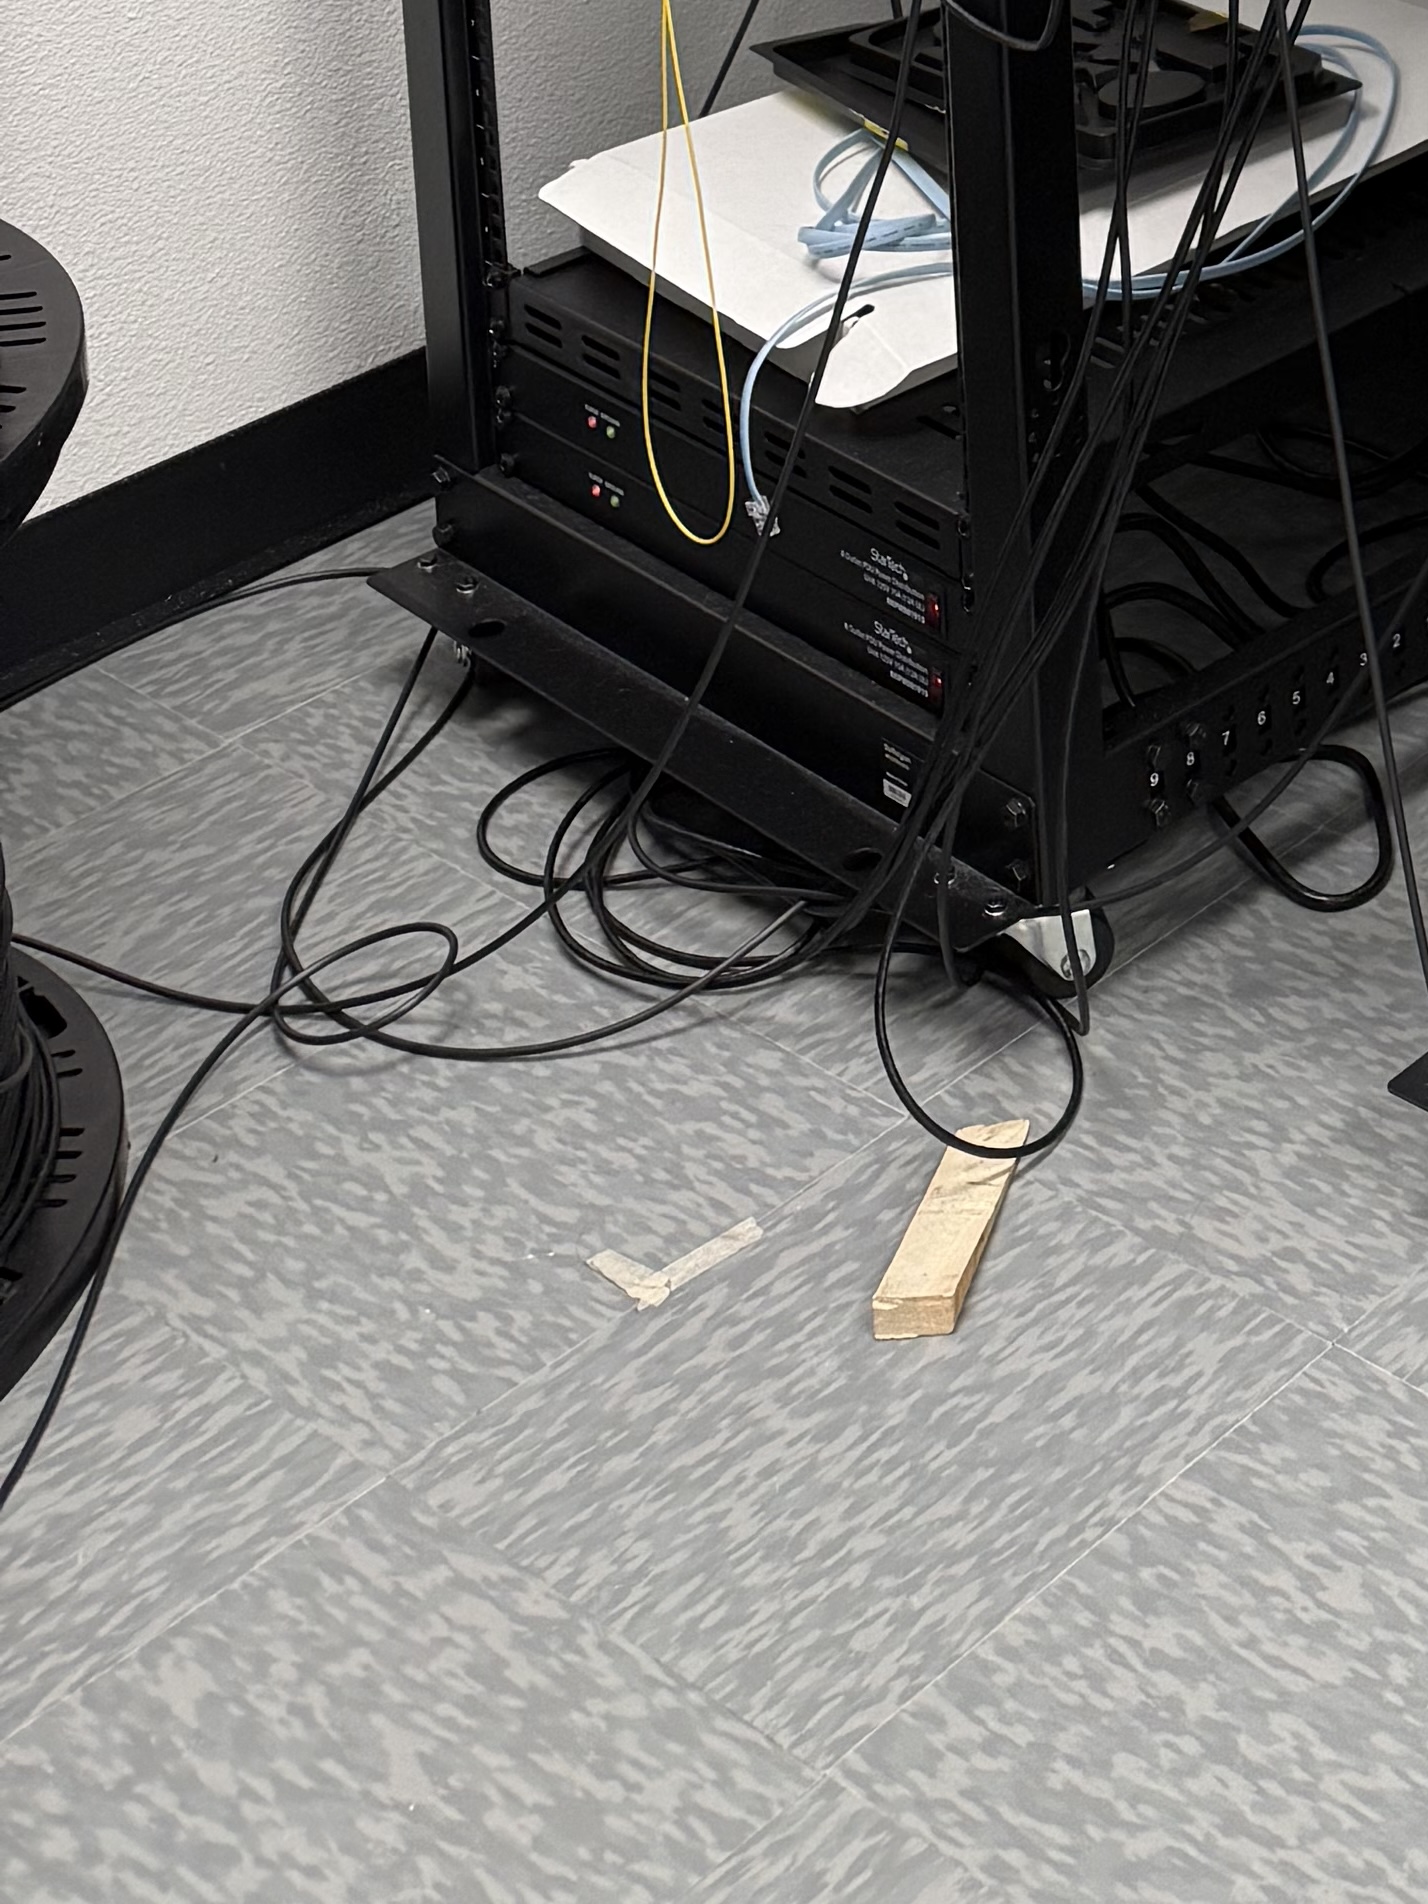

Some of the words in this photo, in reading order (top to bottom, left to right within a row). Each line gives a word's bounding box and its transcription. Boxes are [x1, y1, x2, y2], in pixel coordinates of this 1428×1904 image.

[1393, 634, 1400, 647] 2
[1293, 691, 1300, 704] 5
[1258, 711, 1266, 725] 6
[1222, 731, 1229, 745] 7
[1187, 752, 1194, 765] 8
[1150, 773, 1158, 786] 9
